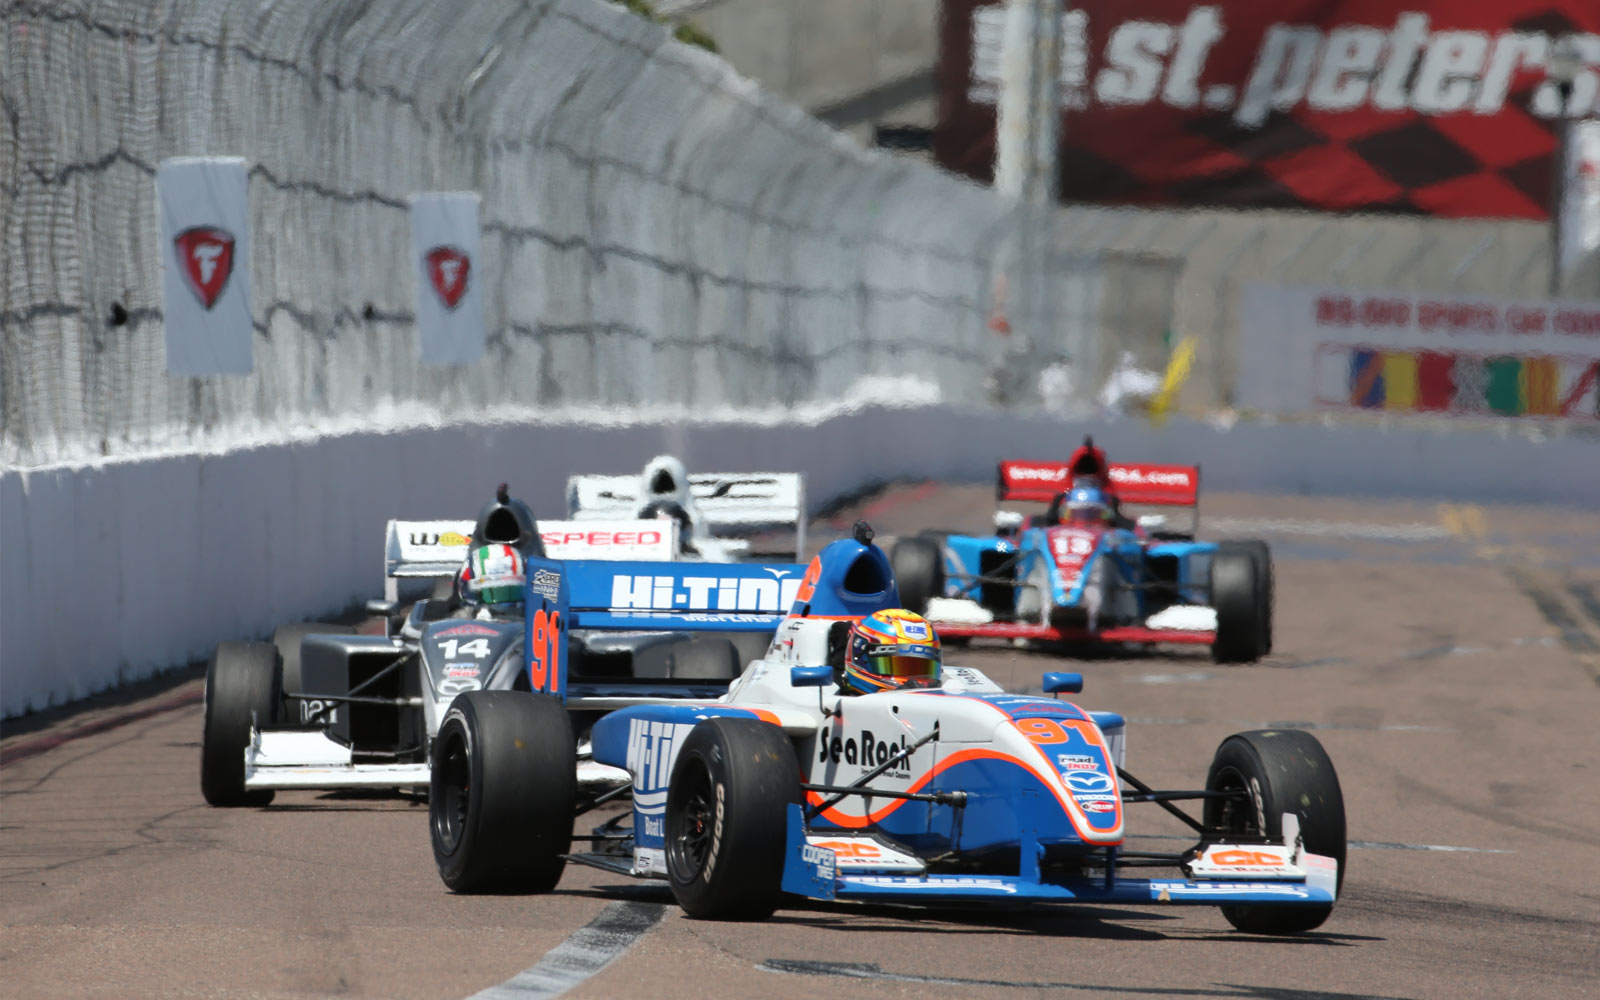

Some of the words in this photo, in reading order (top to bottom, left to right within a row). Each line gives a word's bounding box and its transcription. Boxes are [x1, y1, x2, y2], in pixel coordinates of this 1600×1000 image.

[438, 638, 491, 659] 14
[531, 608, 560, 693] 91
[1015, 718, 1103, 746] 91
[802, 844, 836, 866] COOPER
